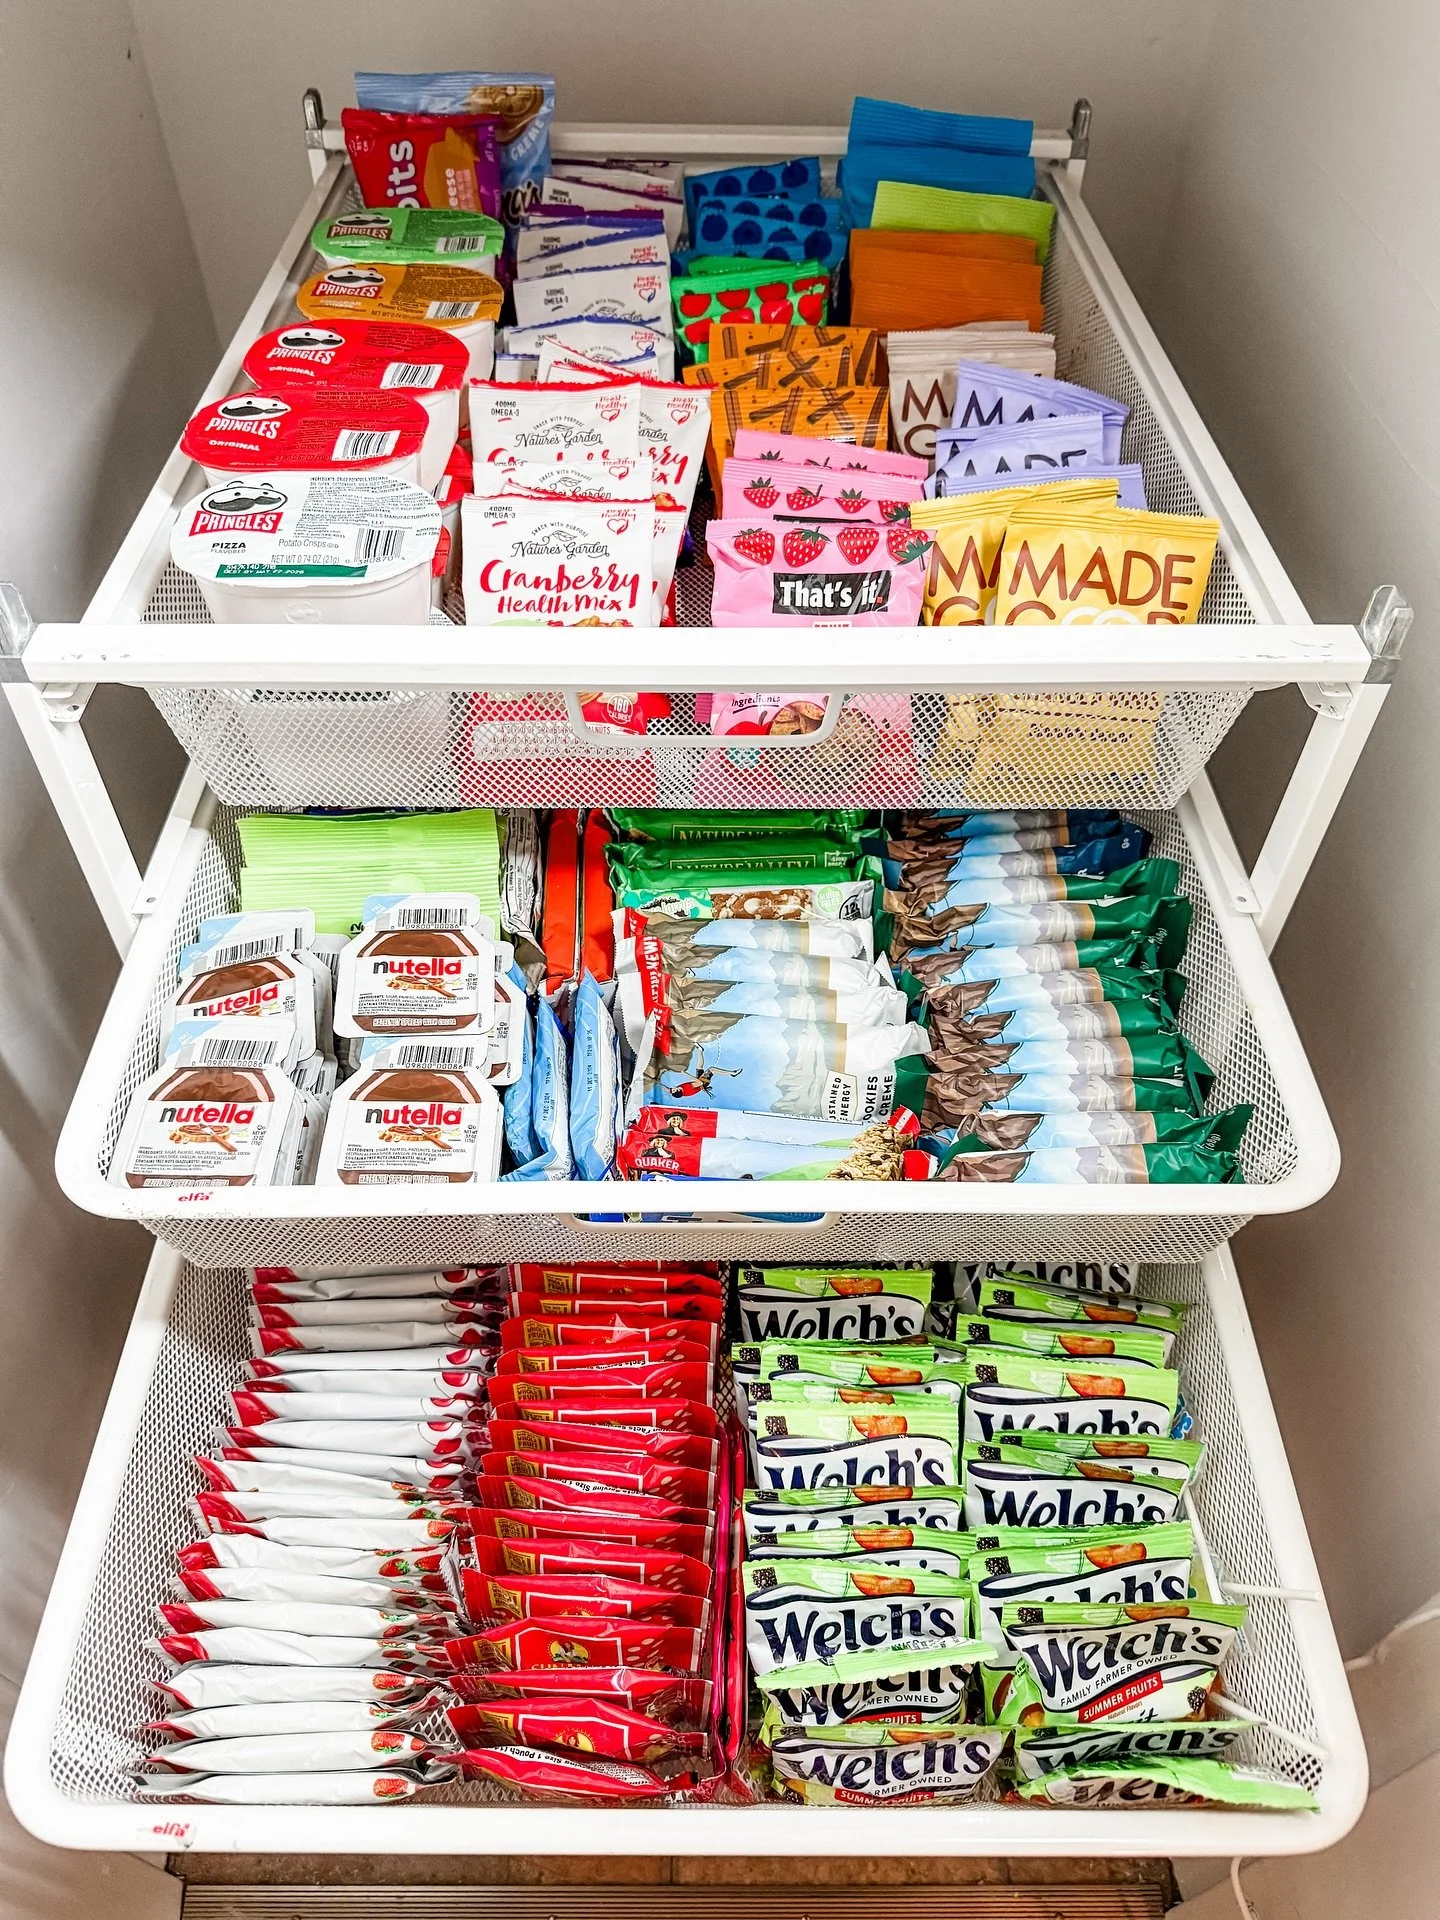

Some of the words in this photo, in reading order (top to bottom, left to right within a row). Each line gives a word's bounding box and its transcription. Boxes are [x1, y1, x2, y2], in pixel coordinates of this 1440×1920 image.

[510, 119, 545, 161] CREME
[331, 226, 390, 240] PRINGLES
[315, 283, 379, 298] PRINGLES
[266, 347, 336, 365] PRINGLES
[269, 366, 316, 377] ORIGINAL
[491, 408, 520, 417] OMEGA-3
[204, 416, 282, 440] PRINGLES
[638, 425, 669, 442] arden
[208, 439, 261, 452] ORIGINAL
[514, 431, 561, 448] Nature's
[563, 429, 604, 449] Garden
[194, 513, 277, 533] PRINGLES
[531, 523, 549, 536] SNACK
[565, 523, 589, 538] PURPOSE
[212, 542, 247, 550] PIZZA
[278, 539, 302, 548] Potato
[303, 539, 327, 549] Crisps
[510, 541, 562, 558] Nature's
[565, 542, 610, 560] Garden
[479, 559, 640, 609] Cranberry
[1008, 539, 1196, 609] MADE
[496, 594, 573, 614] Health
[779, 580, 853, 608] That's
[613, 699, 629, 714] 160
[608, 711, 632, 723] CALORIES
[822, 900, 841, 909] FREE
[373, 957, 462, 977] nutella
[193, 985, 279, 1017] nutella
[863, 1075, 879, 1121] OOKIES
[878, 1074, 894, 1116] CREME
[159, 1103, 255, 1124] nutella
[365, 1103, 462, 1125] nutella
[634, 1156, 681, 1172] QUAKER
[178, 1191, 211, 1202] elfa
[742, 1304, 915, 1342] Welch's
[528, 1332, 547, 1340] FRUIT
[973, 1408, 1160, 1441] Wlch's
[763, 1447, 946, 1490] Welch's
[576, 1481, 591, 1492] Size
[975, 1484, 1166, 1527] Welch's
[755, 1602, 957, 1664] Welch's
[1022, 1623, 1223, 1698] Welch's
[1060, 1684, 1092, 1708] FAMILY
[1095, 1663, 1133, 1691] FARMER
[1136, 1653, 1178, 1667] OWNED
[770, 1664, 973, 1726] Welchs
[895, 1694, 939, 1704] OWNED
[1083, 1694, 1124, 1721] SUMMER
[1125, 1676, 1159, 1701] FRUITS
[1107, 1708, 1126, 1720] Natural
[1126, 1701, 1143, 1713] Flavors
[509, 1747, 536, 1759] Pouch
[544, 1755, 563, 1764] Size
[780, 1736, 991, 1788] Welch's
[873, 1784, 905, 1797] RMER
[909, 1776, 952, 1787] OWNED
[152, 1821, 186, 1838] elfa
